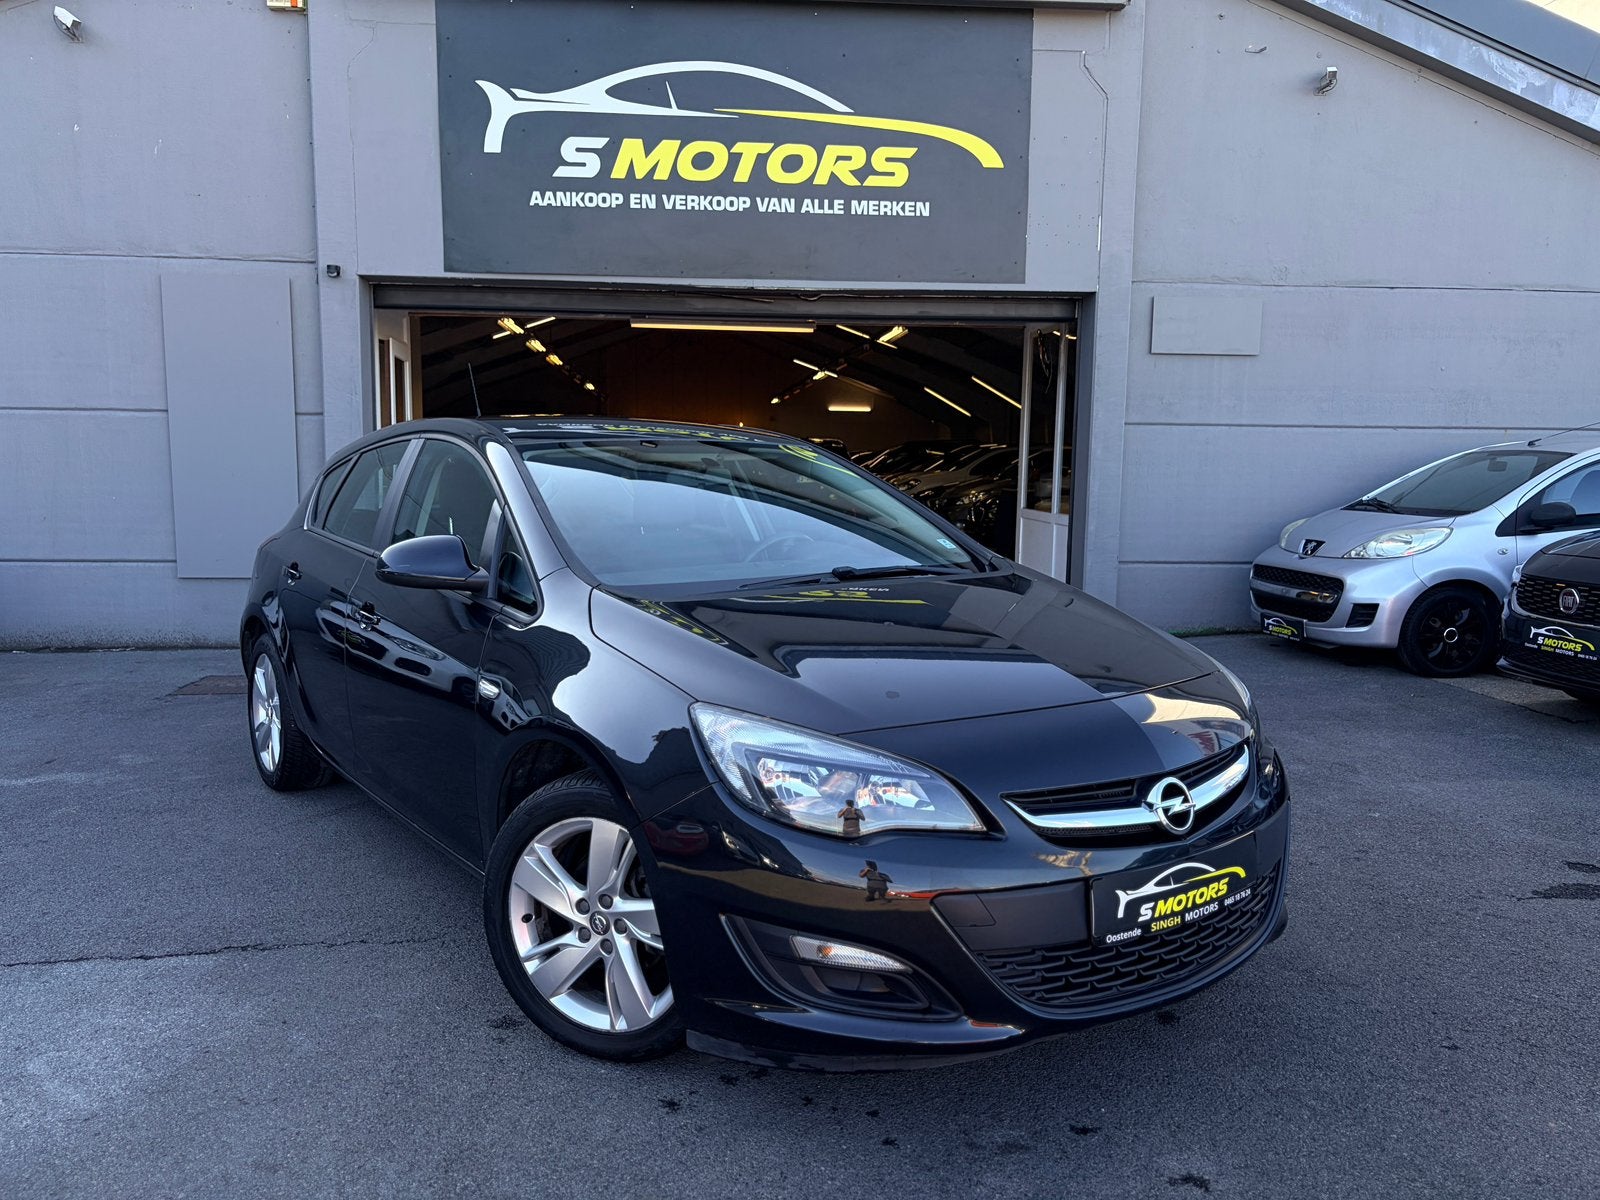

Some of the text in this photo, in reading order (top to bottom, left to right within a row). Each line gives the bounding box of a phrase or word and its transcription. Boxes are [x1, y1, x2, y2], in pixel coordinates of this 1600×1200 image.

[551, 136, 919, 188] S MOTORS
[529, 190, 930, 217] AANKOOP EN VERKOOP VAN ALLE MERKEN
[1537, 636, 1544, 644] S
[1544, 638, 1583, 652] MOTORS
[1137, 877, 1230, 922] S MOTORS
[1106, 927, 1142, 944] Oostende
[1151, 915, 1182, 932] SINGH
[1185, 901, 1219, 922] MOTORS
